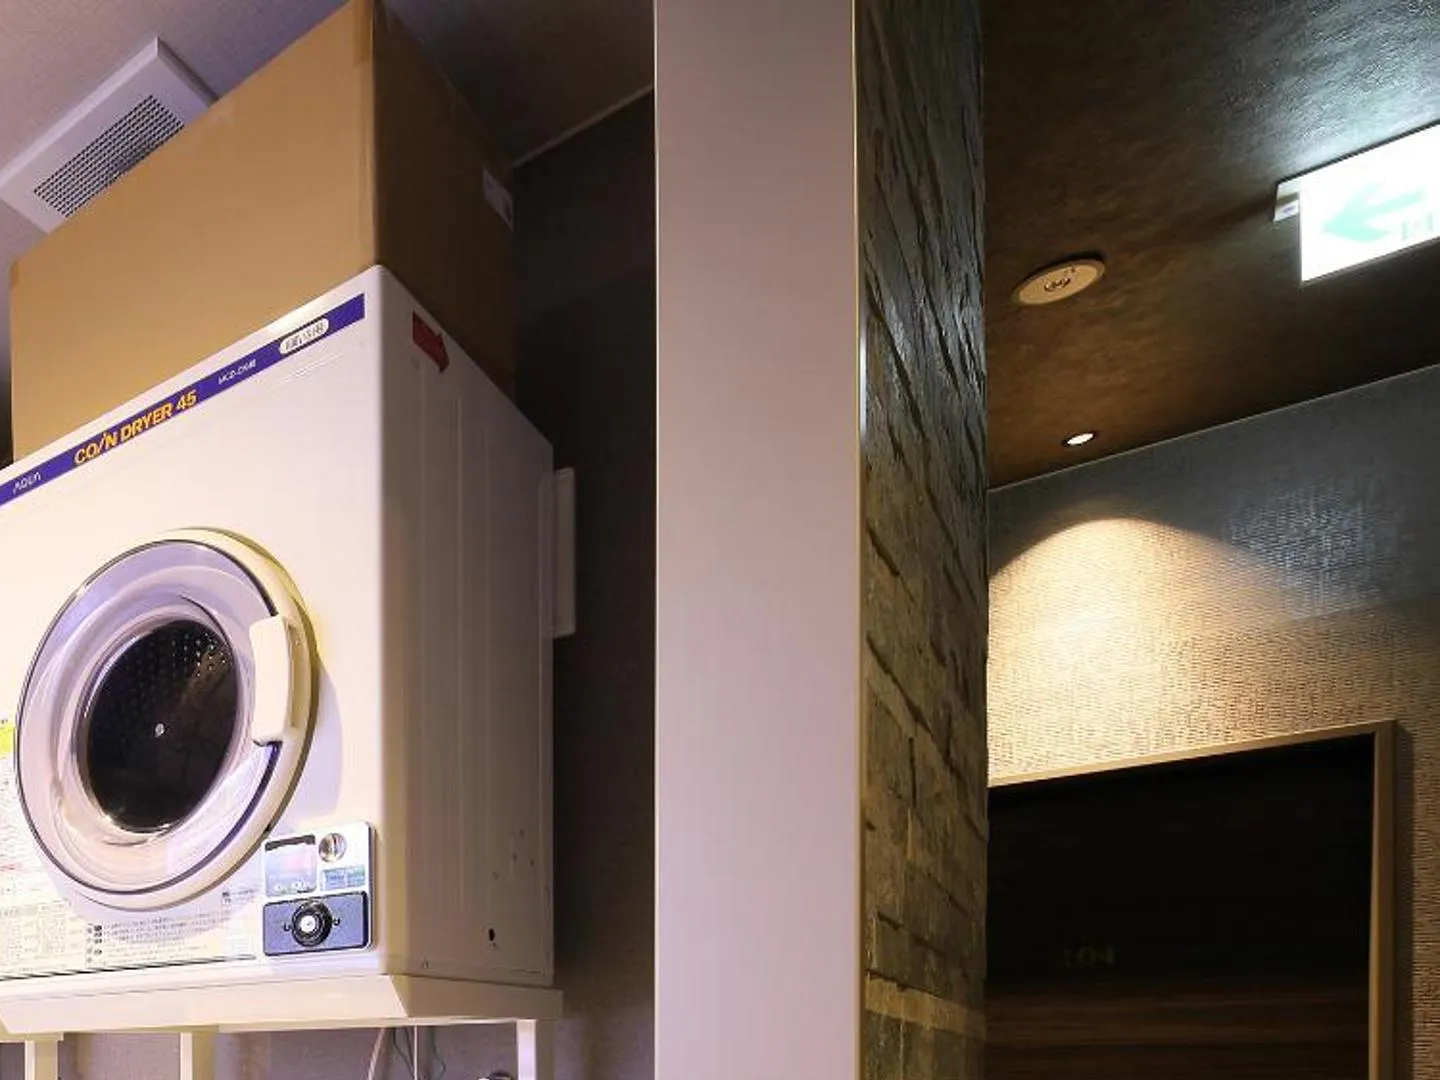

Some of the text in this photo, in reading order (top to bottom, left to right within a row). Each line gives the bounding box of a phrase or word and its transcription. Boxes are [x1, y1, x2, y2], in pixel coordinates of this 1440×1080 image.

[74, 430, 118, 465] COIN
[120, 402, 174, 442] DRYER
[176, 389, 198, 412] 45
